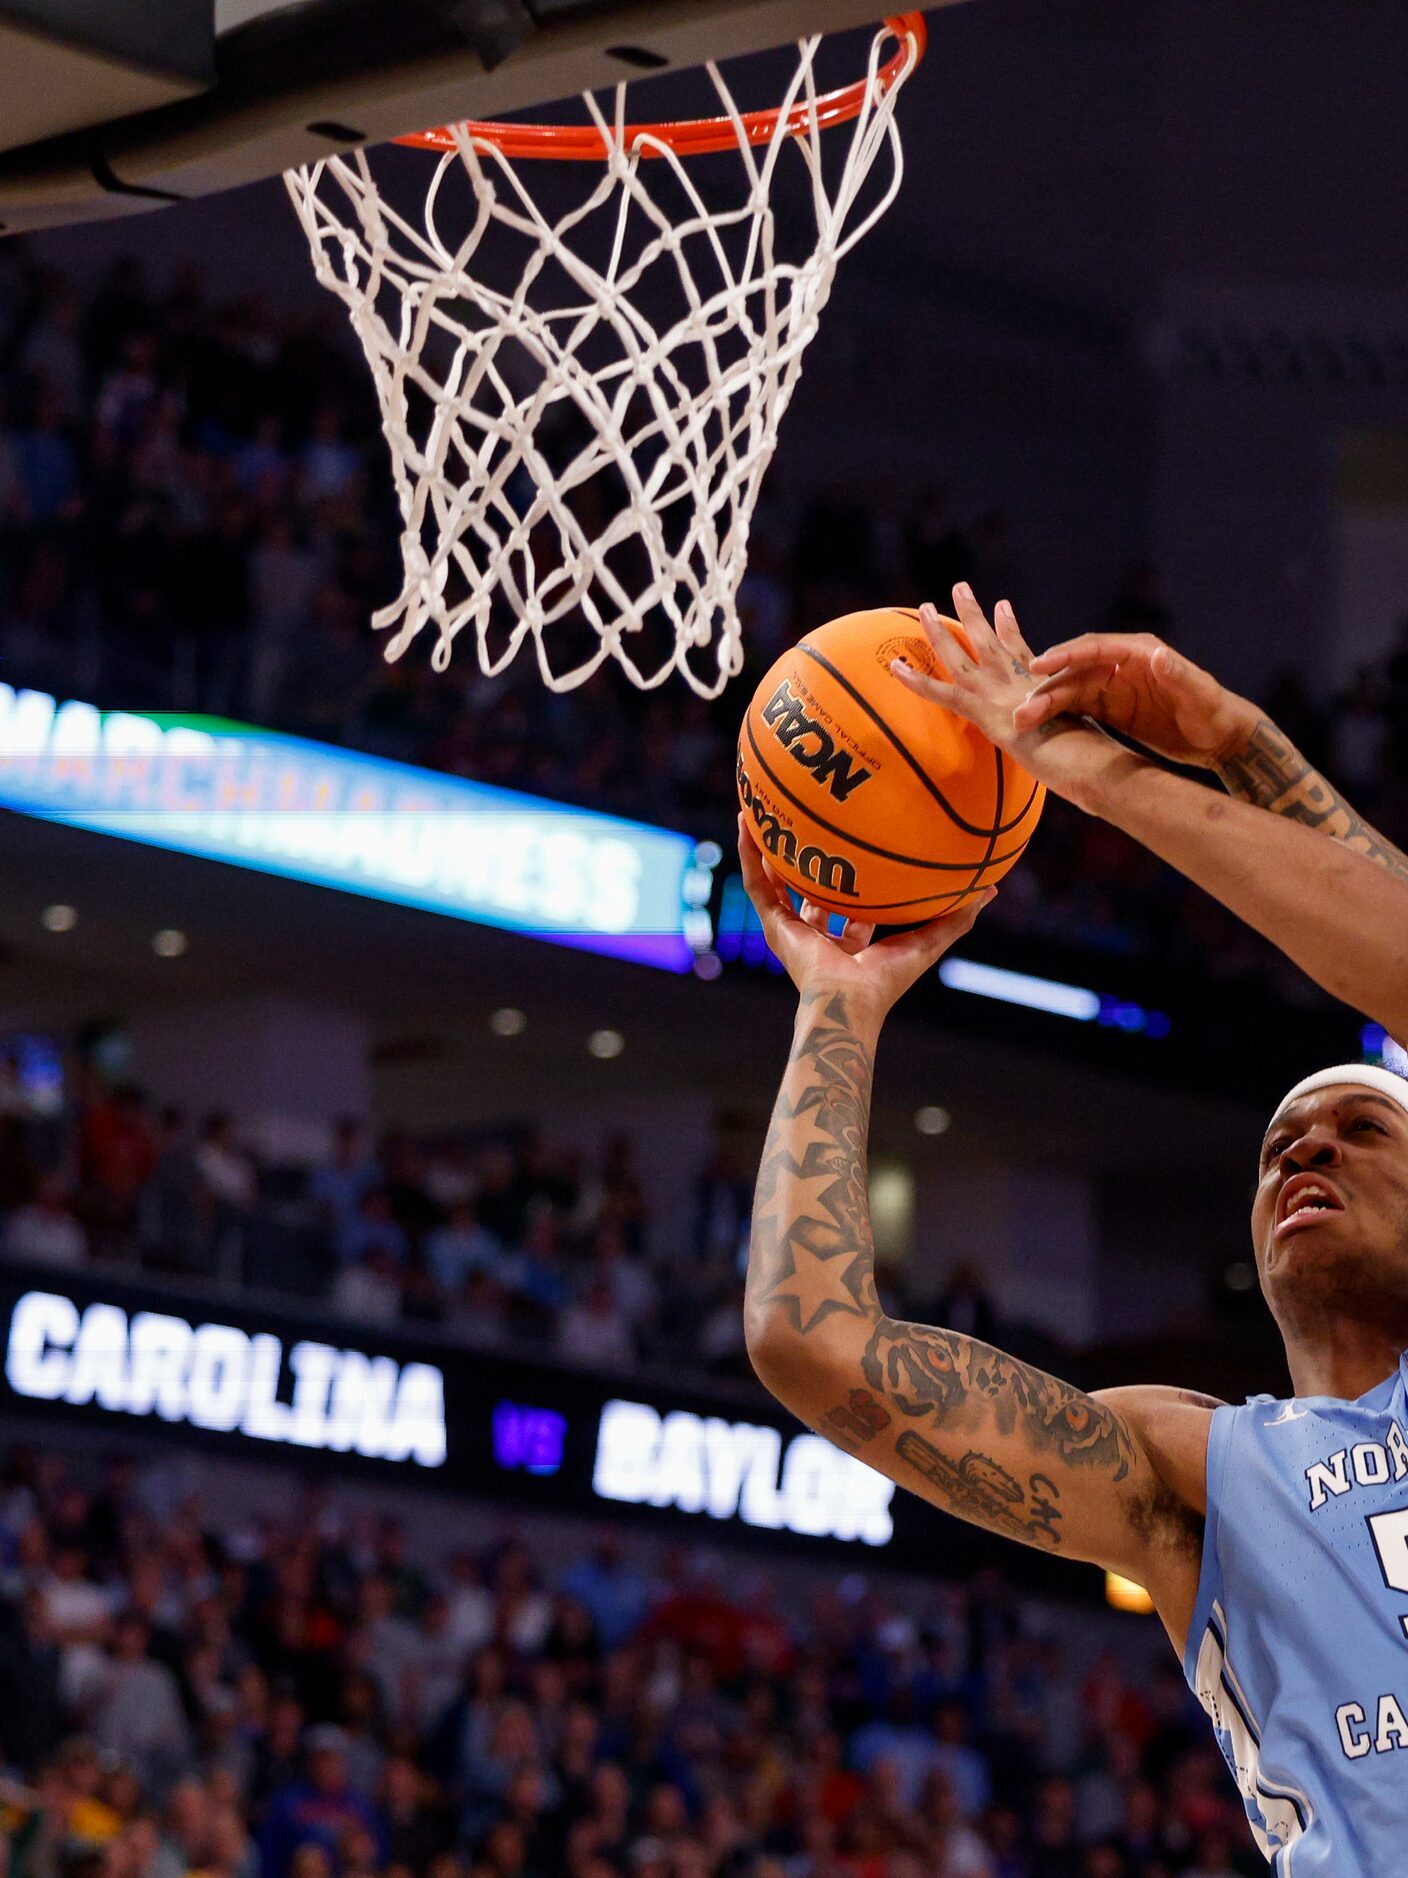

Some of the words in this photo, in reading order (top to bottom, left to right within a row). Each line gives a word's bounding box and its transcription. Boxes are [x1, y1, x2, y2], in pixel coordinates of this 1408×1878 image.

[761, 679, 872, 804] NCAA
[835, 724, 882, 770] OFFICIAL
[5, 1291, 447, 1468] CAROLINA
[592, 1398, 896, 1548] BAYLOR
